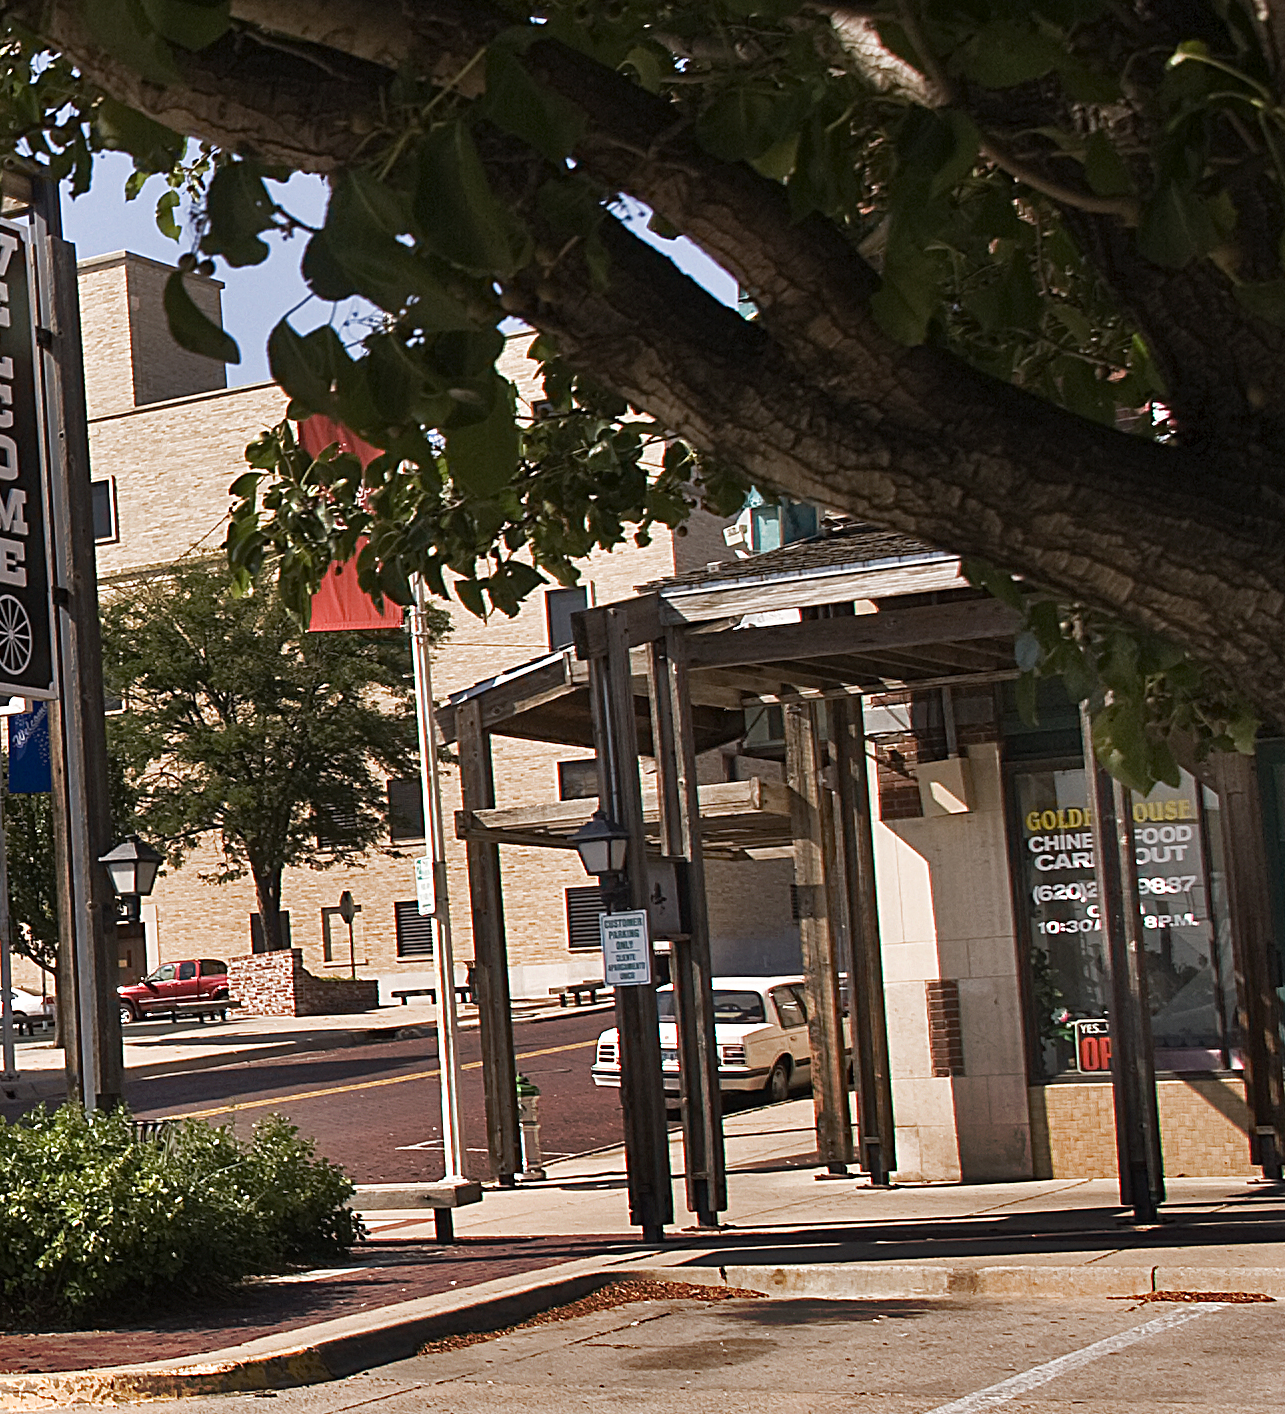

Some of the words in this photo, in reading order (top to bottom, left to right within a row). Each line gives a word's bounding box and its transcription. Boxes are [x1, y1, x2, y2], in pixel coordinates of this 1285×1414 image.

[1026, 807, 1093, 831] GOLDE
[1132, 799, 1191, 823] OUSE
[1028, 832, 1094, 852] CHINE
[1034, 851, 1096, 871] CAR
[1135, 844, 1188, 865] OUT
[604, 918, 642, 928] CUSTOMER
[608, 929, 640, 939] PARKING
[1081, 1036, 1112, 1070] OP
